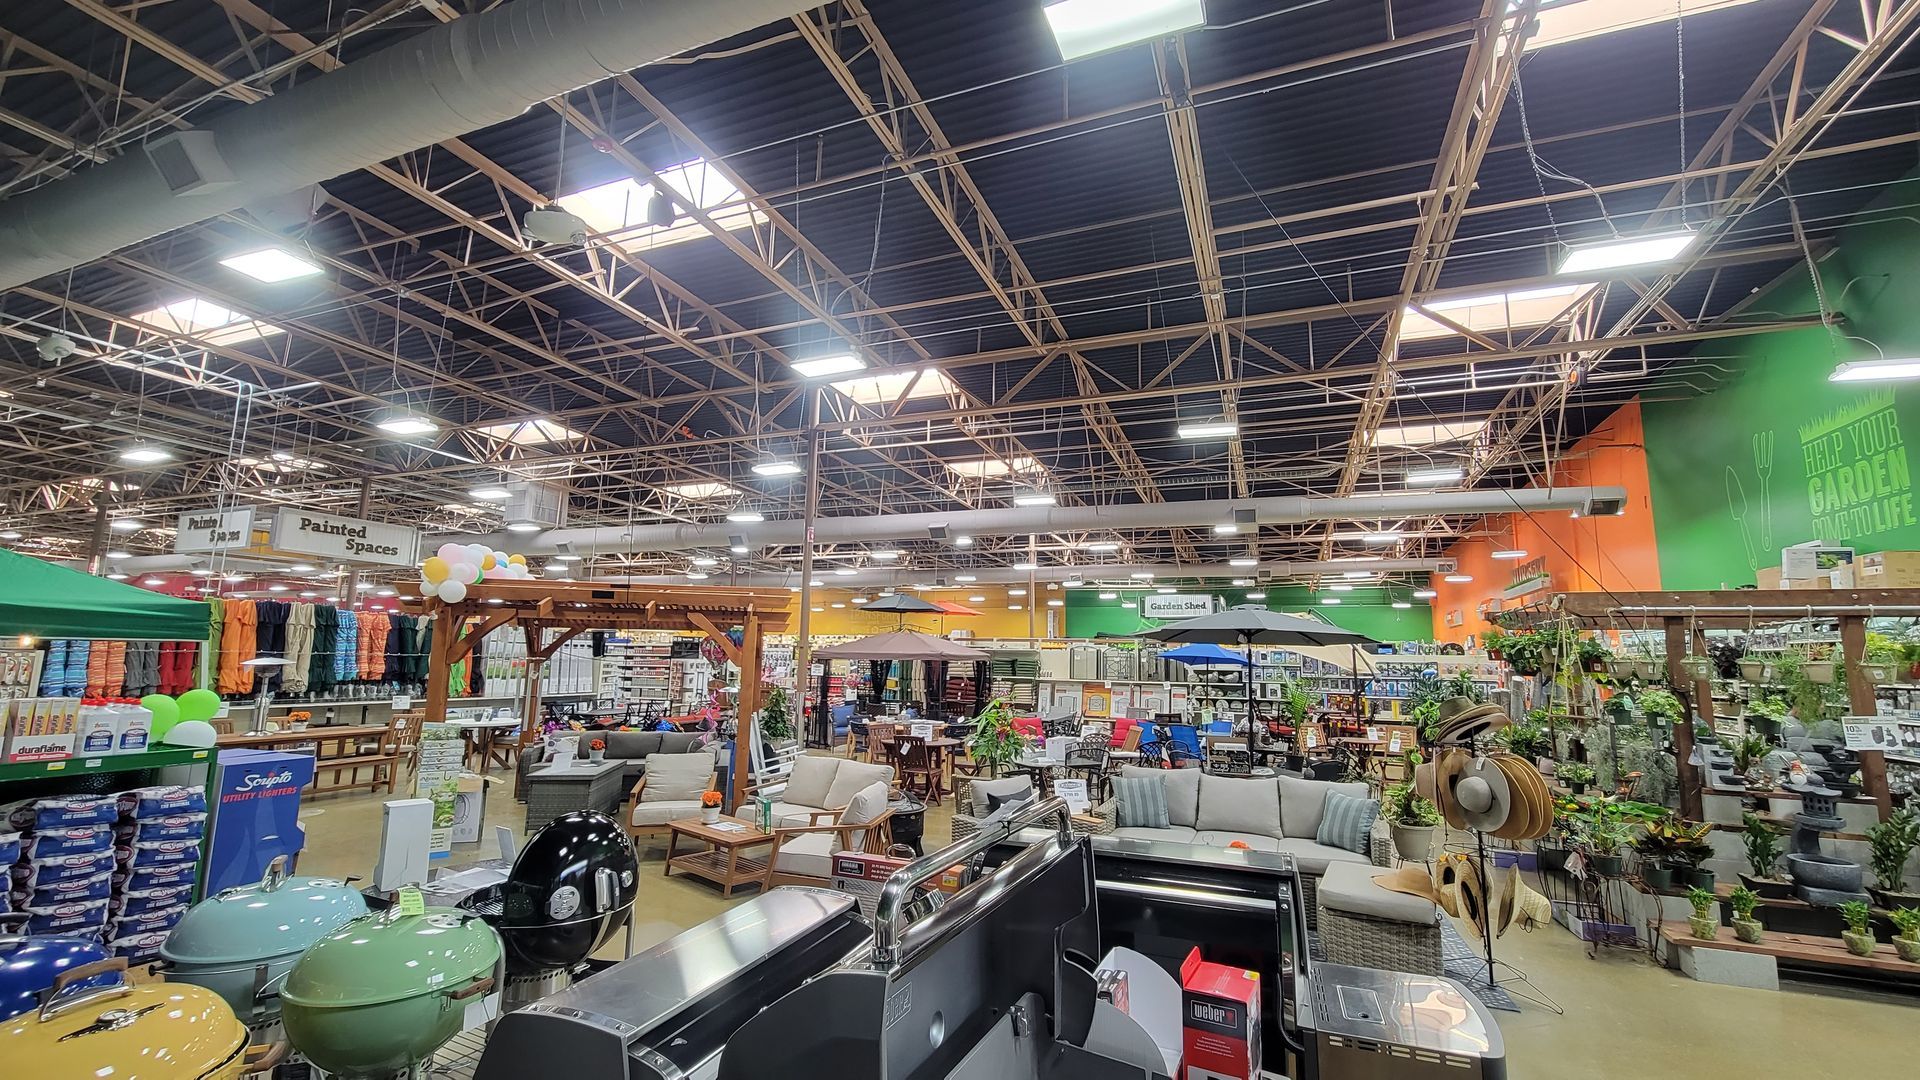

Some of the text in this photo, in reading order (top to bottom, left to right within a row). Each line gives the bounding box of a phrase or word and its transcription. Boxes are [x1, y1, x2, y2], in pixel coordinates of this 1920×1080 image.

[1802, 408, 1903, 477] HELP YOUR
[1808, 446, 1911, 516] GARDEN
[1812, 493, 1917, 540] COME TO LIFE
[210, 529, 240, 545] Spaes
[300, 517, 367, 539] Painted
[346, 538, 398, 556] Spaces
[1151, 601, 1207, 610] Garden Shed
[18, 743, 66, 754] duraflame
[235, 770, 292, 791] Scripto
[222, 787, 297, 803] UTILITY LIGHTERS
[1194, 1003, 1225, 1023] weber
